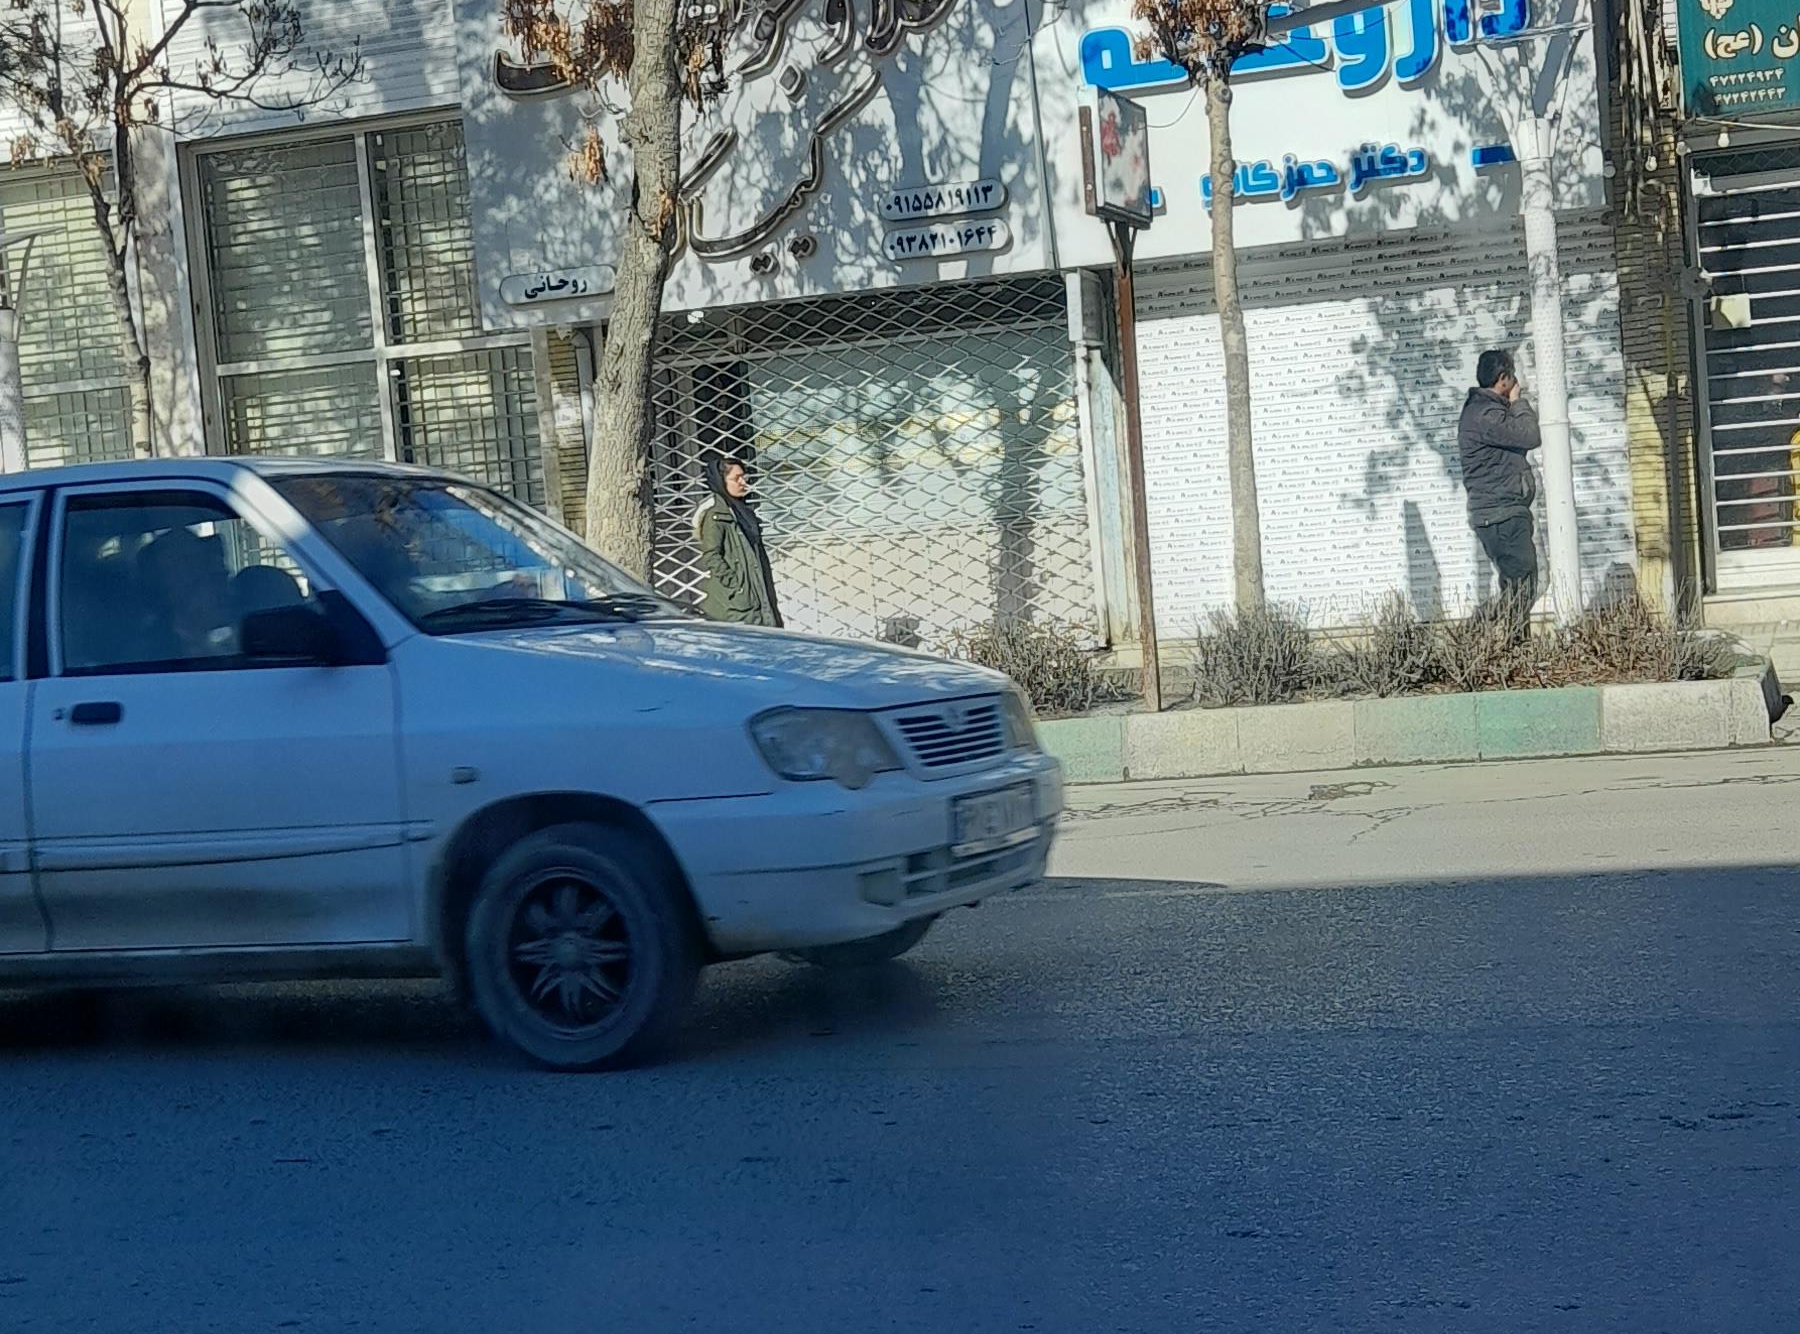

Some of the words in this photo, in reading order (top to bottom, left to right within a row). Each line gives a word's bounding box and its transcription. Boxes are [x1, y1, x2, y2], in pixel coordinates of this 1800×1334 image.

[1704, 23, 1763, 60] (عج)
[1350, 142, 1428, 194] دکتر
[886, 184, 994, 214] ۰۹۱۵۵۸۱۹۱۱۳
[524, 275, 588, 299] روحانی
